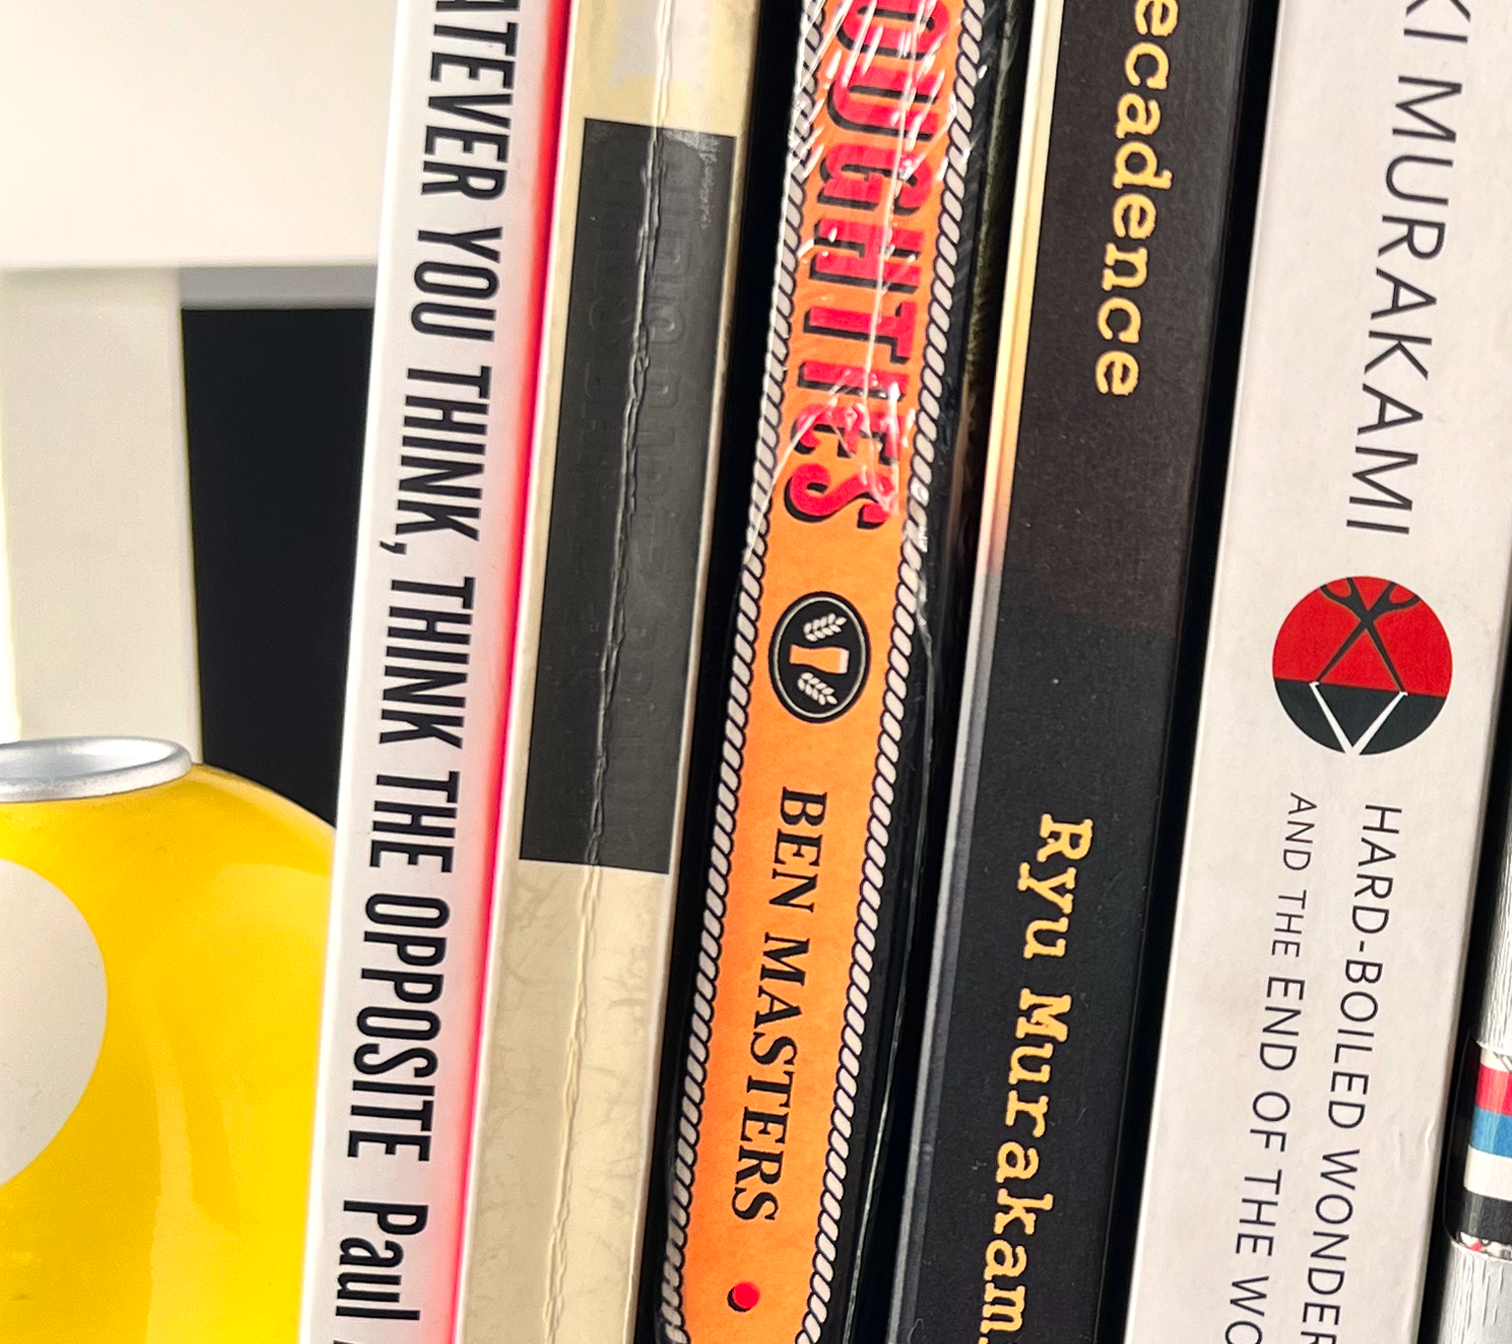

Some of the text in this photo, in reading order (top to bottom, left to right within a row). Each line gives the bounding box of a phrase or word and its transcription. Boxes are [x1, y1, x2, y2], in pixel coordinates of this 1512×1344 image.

[410, 226, 503, 342] YOU
[1345, 75, 1463, 535] MURAKAMI
[379, 364, 492, 555] THINK,
[378, 576, 476, 750] THINK
[369, 770, 461, 874] THE
[1282, 791, 1317, 872] AND
[1018, 814, 1093, 960] Ryu
[1271, 889, 1308, 958] THE
[346, 892, 451, 1162] OPPOSITE
[731, 786, 828, 1221] BEN MASTERS
[1258, 976, 1306, 1072] END
[1327, 804, 1403, 1130] HARD-BOILED
[1249, 1091, 1292, 1153] OF
[334, 1200, 429, 1322] Paul
[1235, 1168, 1282, 1257] THE
